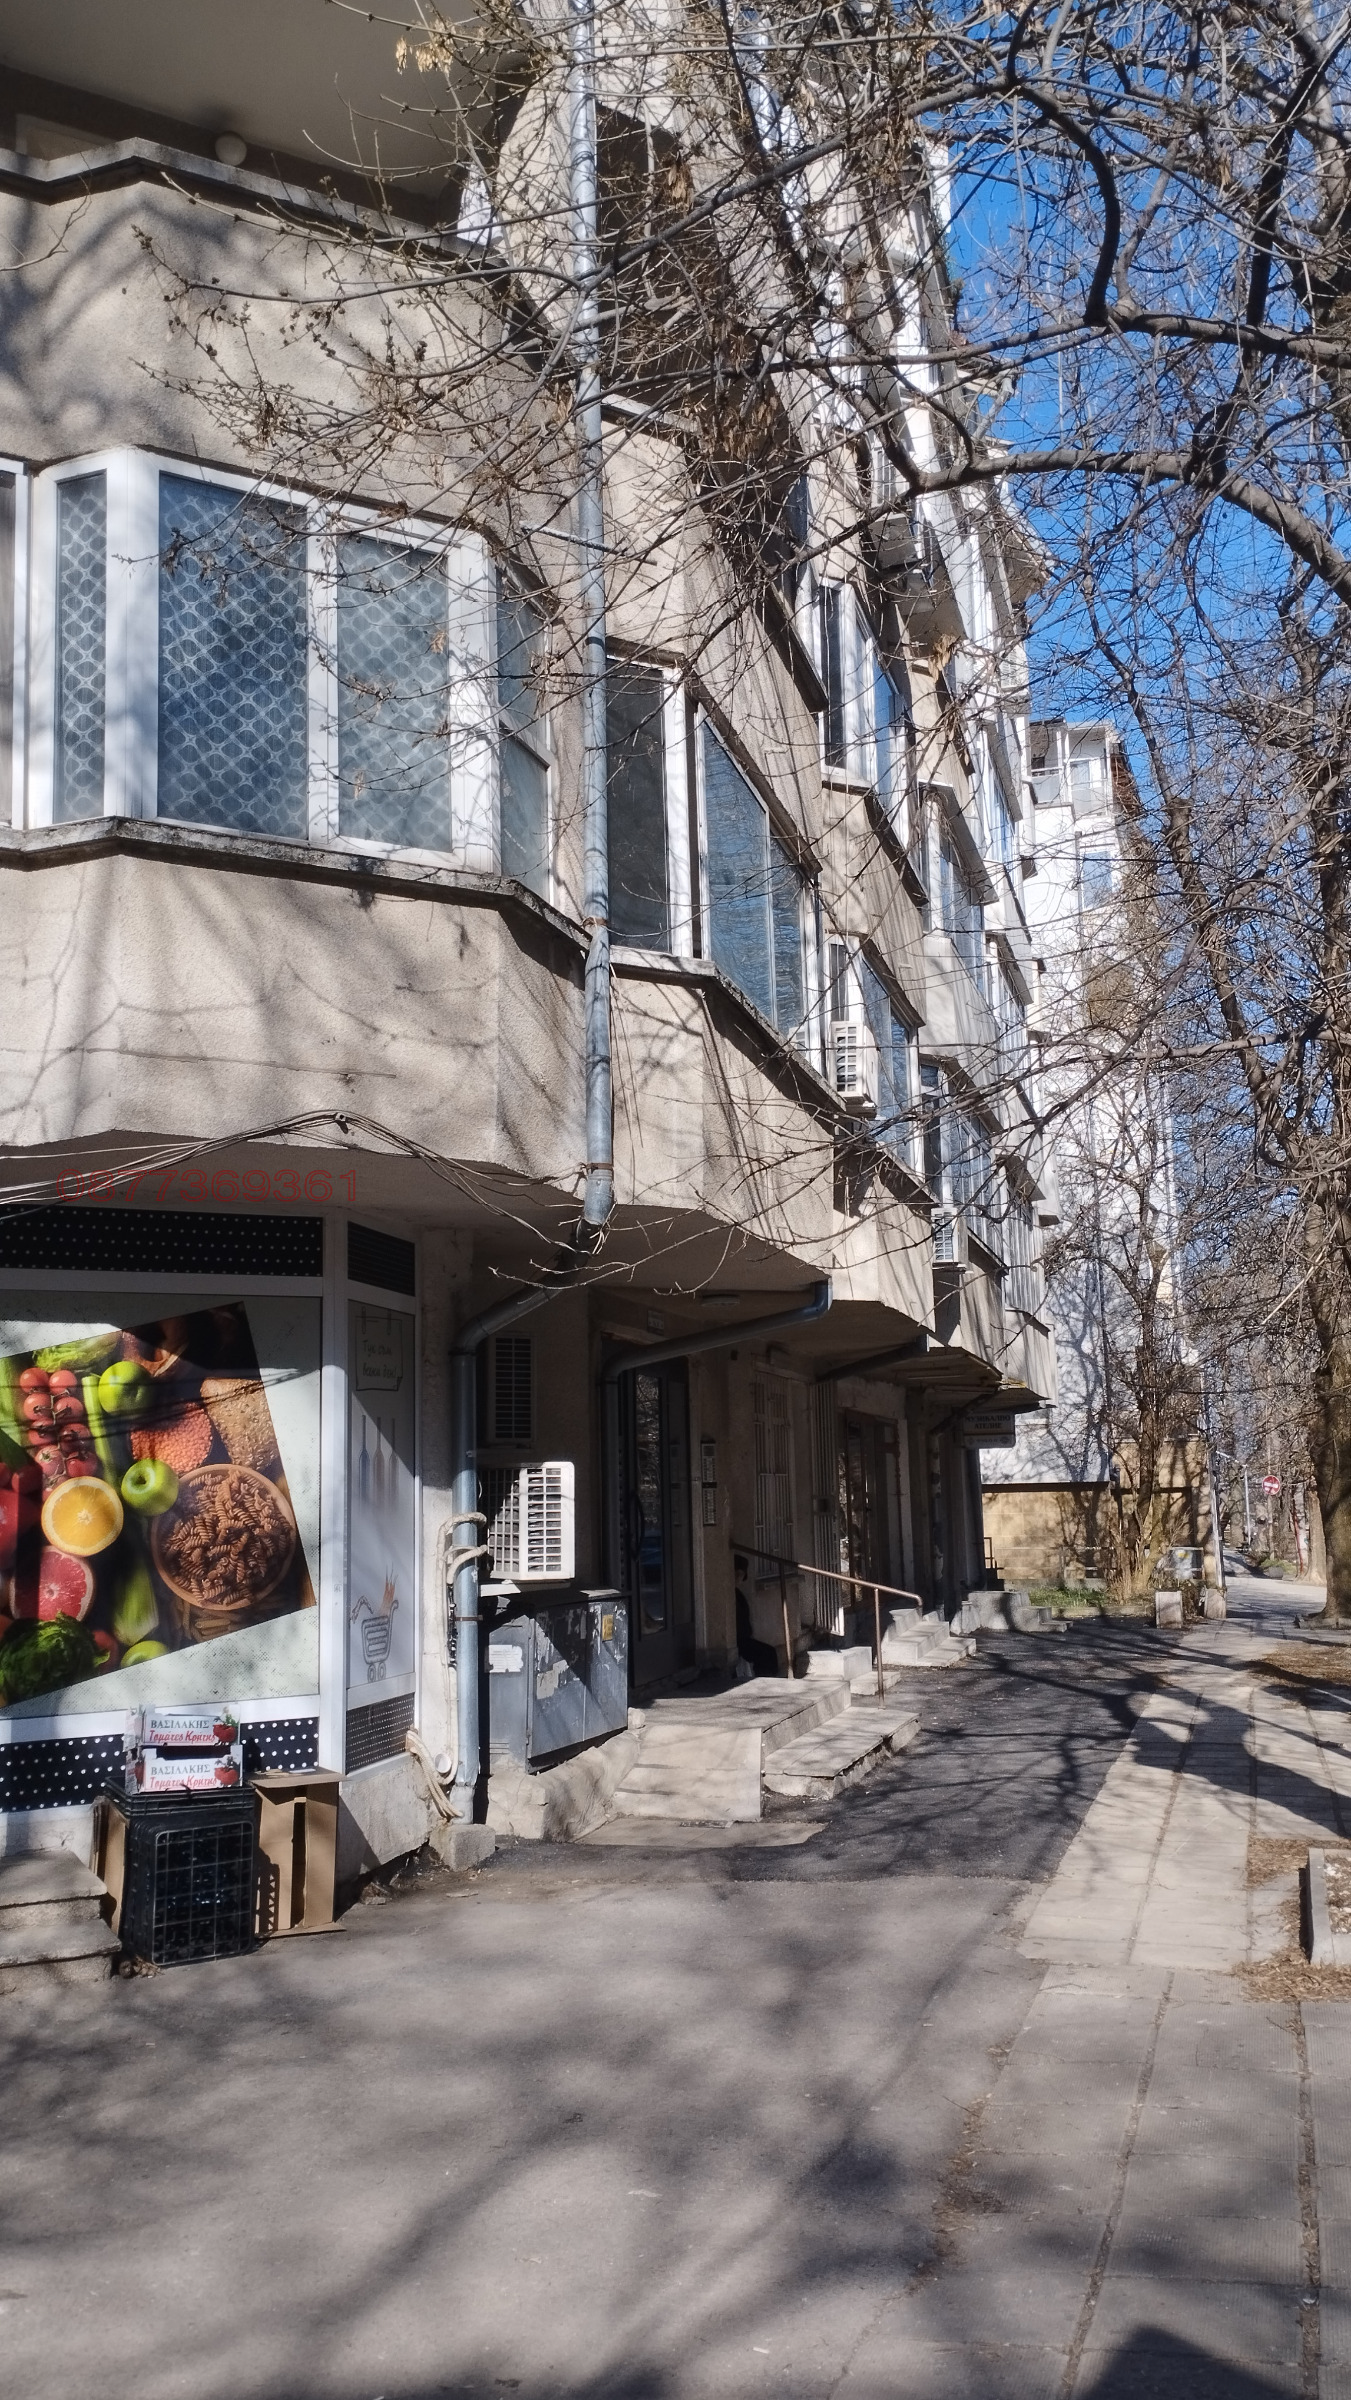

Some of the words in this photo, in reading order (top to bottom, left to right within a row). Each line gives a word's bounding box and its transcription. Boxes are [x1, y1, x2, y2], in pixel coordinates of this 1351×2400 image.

[362, 1339, 376, 1357] Тук
[150, 1719, 210, 1729] ΒΑΣΙΛΑΚΗΣ
[151, 1764, 211, 1775] ΒΑΣΙΛΑΚΗΣ
